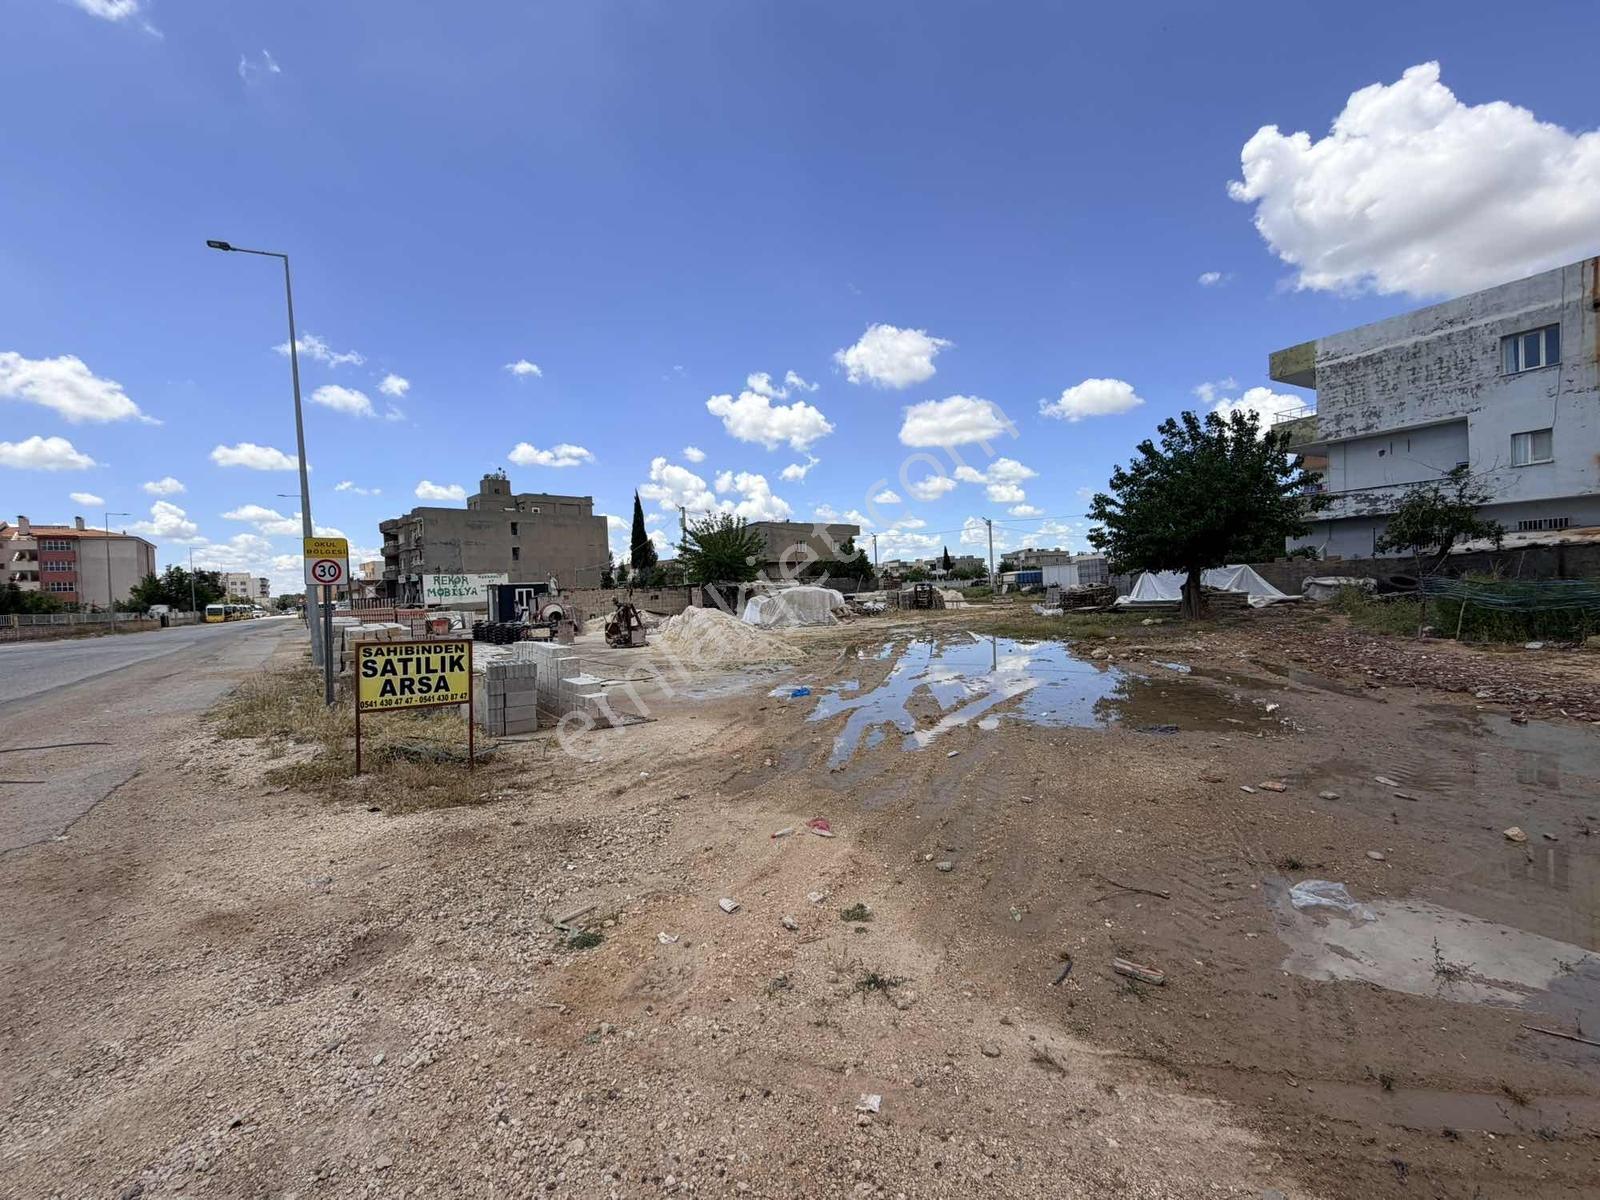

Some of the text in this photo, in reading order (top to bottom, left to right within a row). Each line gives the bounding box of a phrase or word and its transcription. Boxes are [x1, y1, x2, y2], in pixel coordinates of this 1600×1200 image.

[314, 541, 337, 549] OKUL
[318, 565, 337, 578] 30
[433, 575, 469, 585] REKOR
[361, 655, 465, 678] SATILIK
[379, 675, 450, 697] ARSA
[360, 700, 377, 709] 0541
[380, 699, 393, 707] 430
[394, 697, 402, 705] 47
[405, 696, 413, 704] 47
[419, 695, 435, 703] 0541
[437, 694, 449, 702] 430
